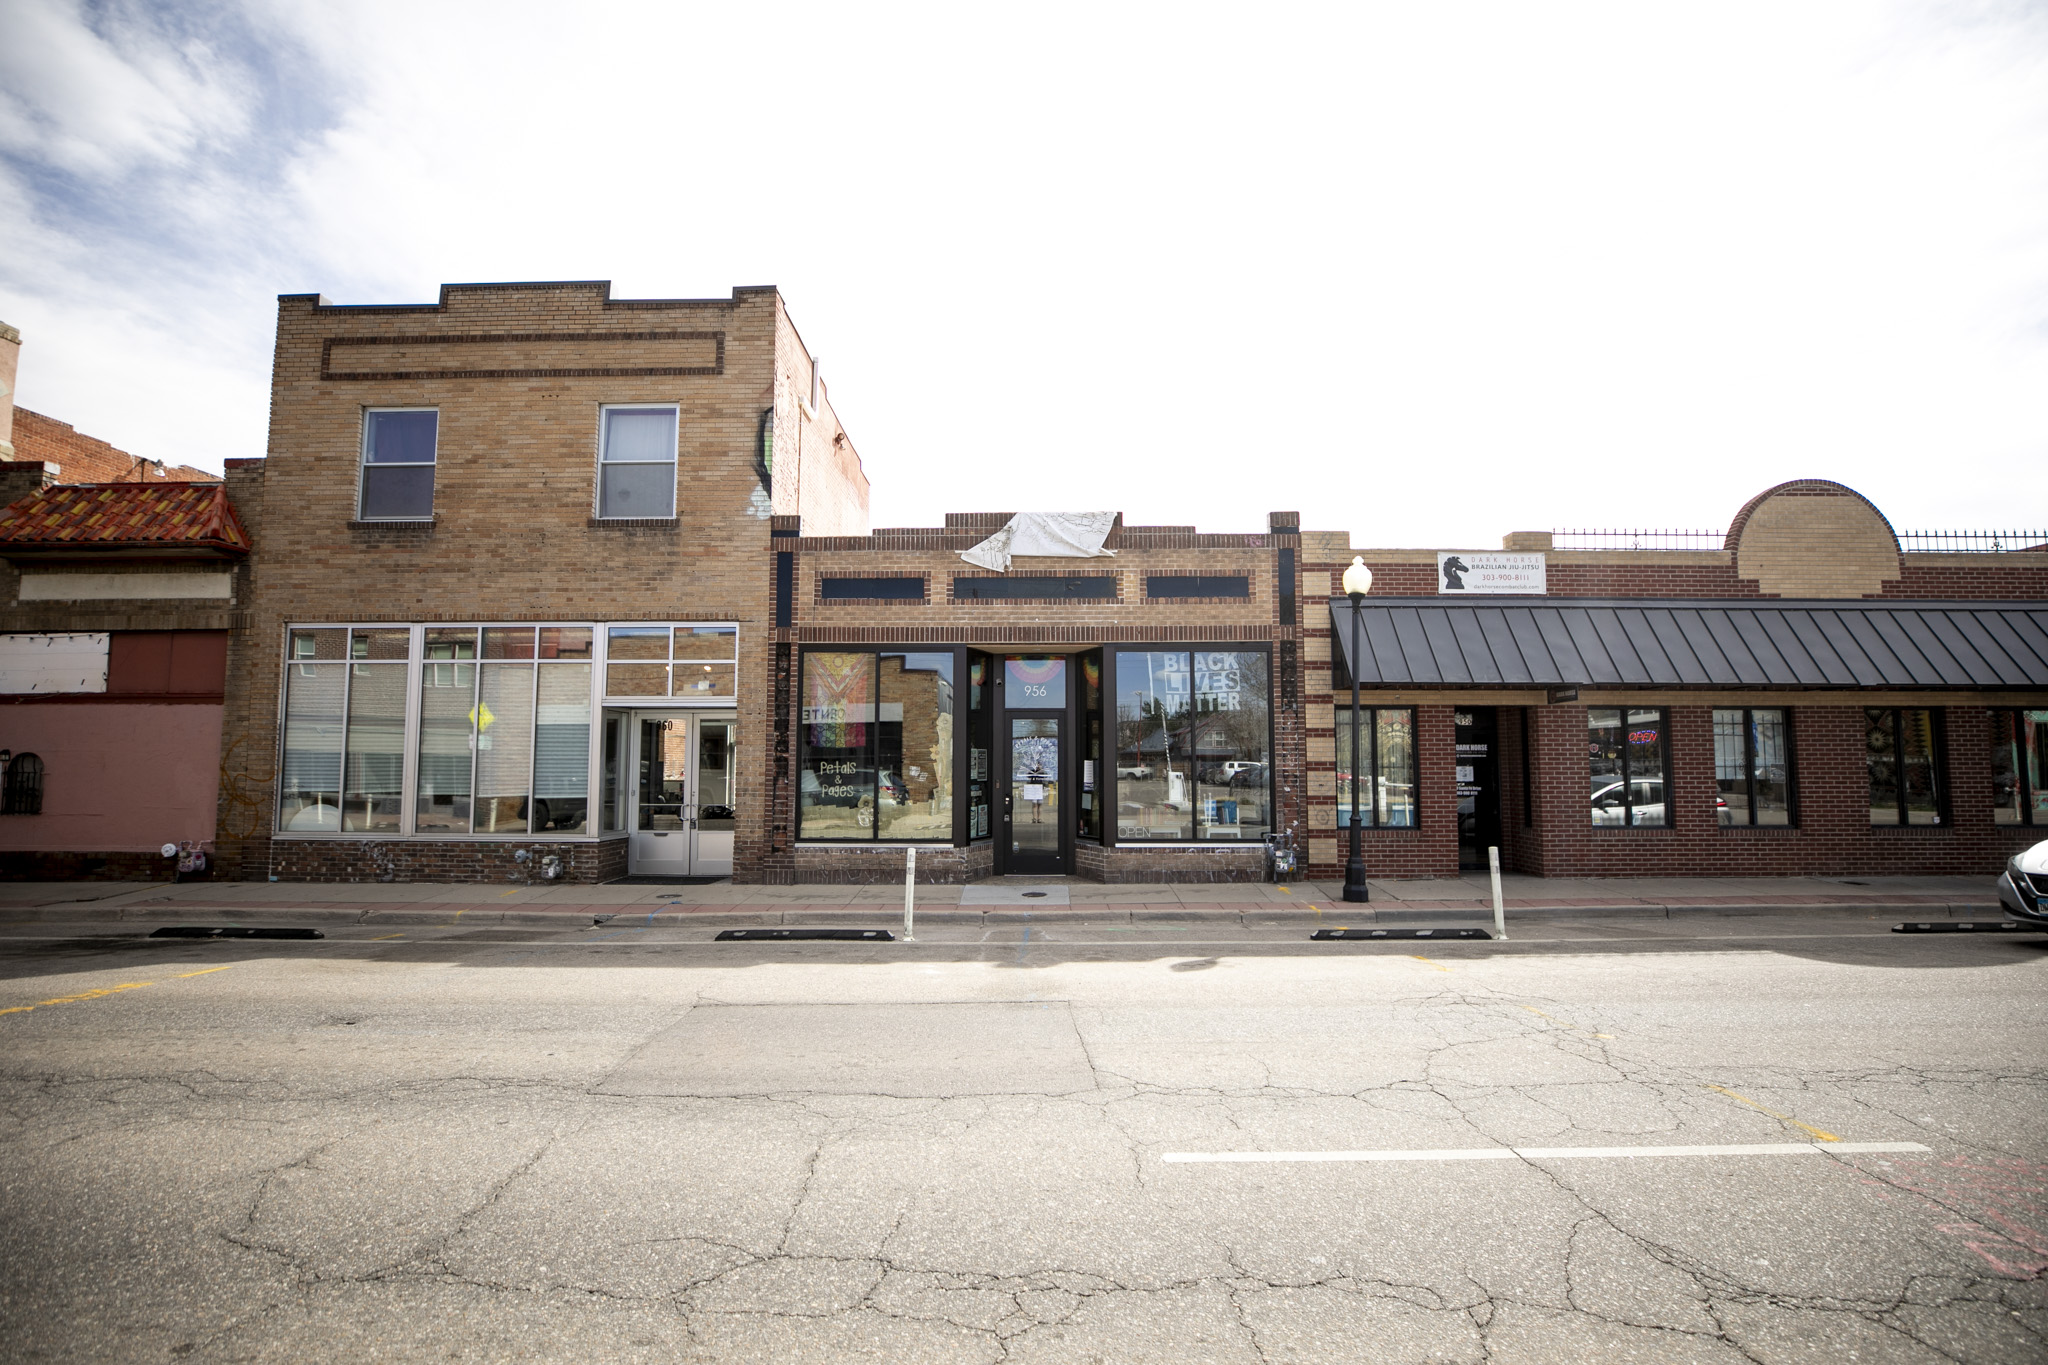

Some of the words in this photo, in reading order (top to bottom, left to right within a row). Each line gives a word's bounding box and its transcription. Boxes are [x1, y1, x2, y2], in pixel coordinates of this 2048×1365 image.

[1164, 654, 1238, 671] BLACK
[1166, 672, 1239, 691] LIVES
[1024, 685, 1047, 697] 956
[656, 720, 673, 731] 960
[1628, 732, 1658, 741] OPEN
[820, 761, 857, 775] Petals
[834, 776, 842, 784] &
[821, 785, 854, 797] Pages
[1118, 827, 1151, 838] OPEN
